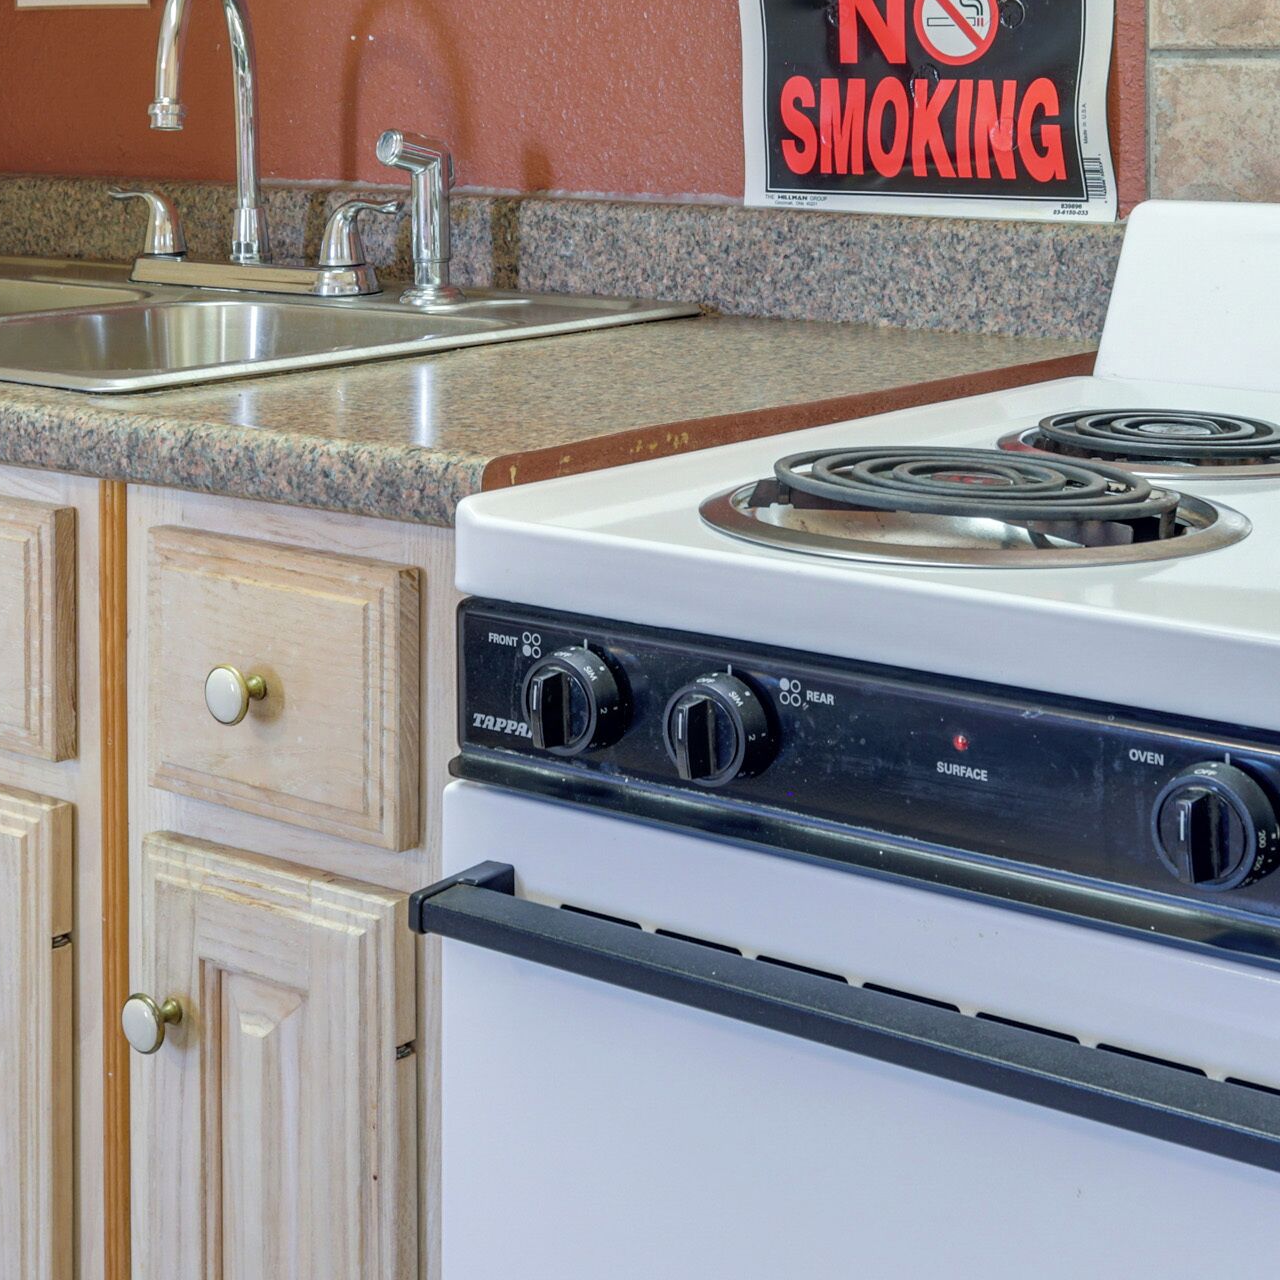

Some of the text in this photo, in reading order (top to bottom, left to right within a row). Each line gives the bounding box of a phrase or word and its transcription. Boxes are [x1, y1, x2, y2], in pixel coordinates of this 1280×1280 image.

[779, 75, 1068, 183] SMOKING
[488, 632, 519, 648] FRONT
[806, 689, 836, 706] REAR
[600, 707, 608, 715] 2
[473, 712, 533, 739] TAPPA
[748, 733, 757, 742] 2
[1128, 748, 1165, 767] OVEN
[936, 760, 989, 782] SURFACE
[1258, 829, 1267, 849] 200
